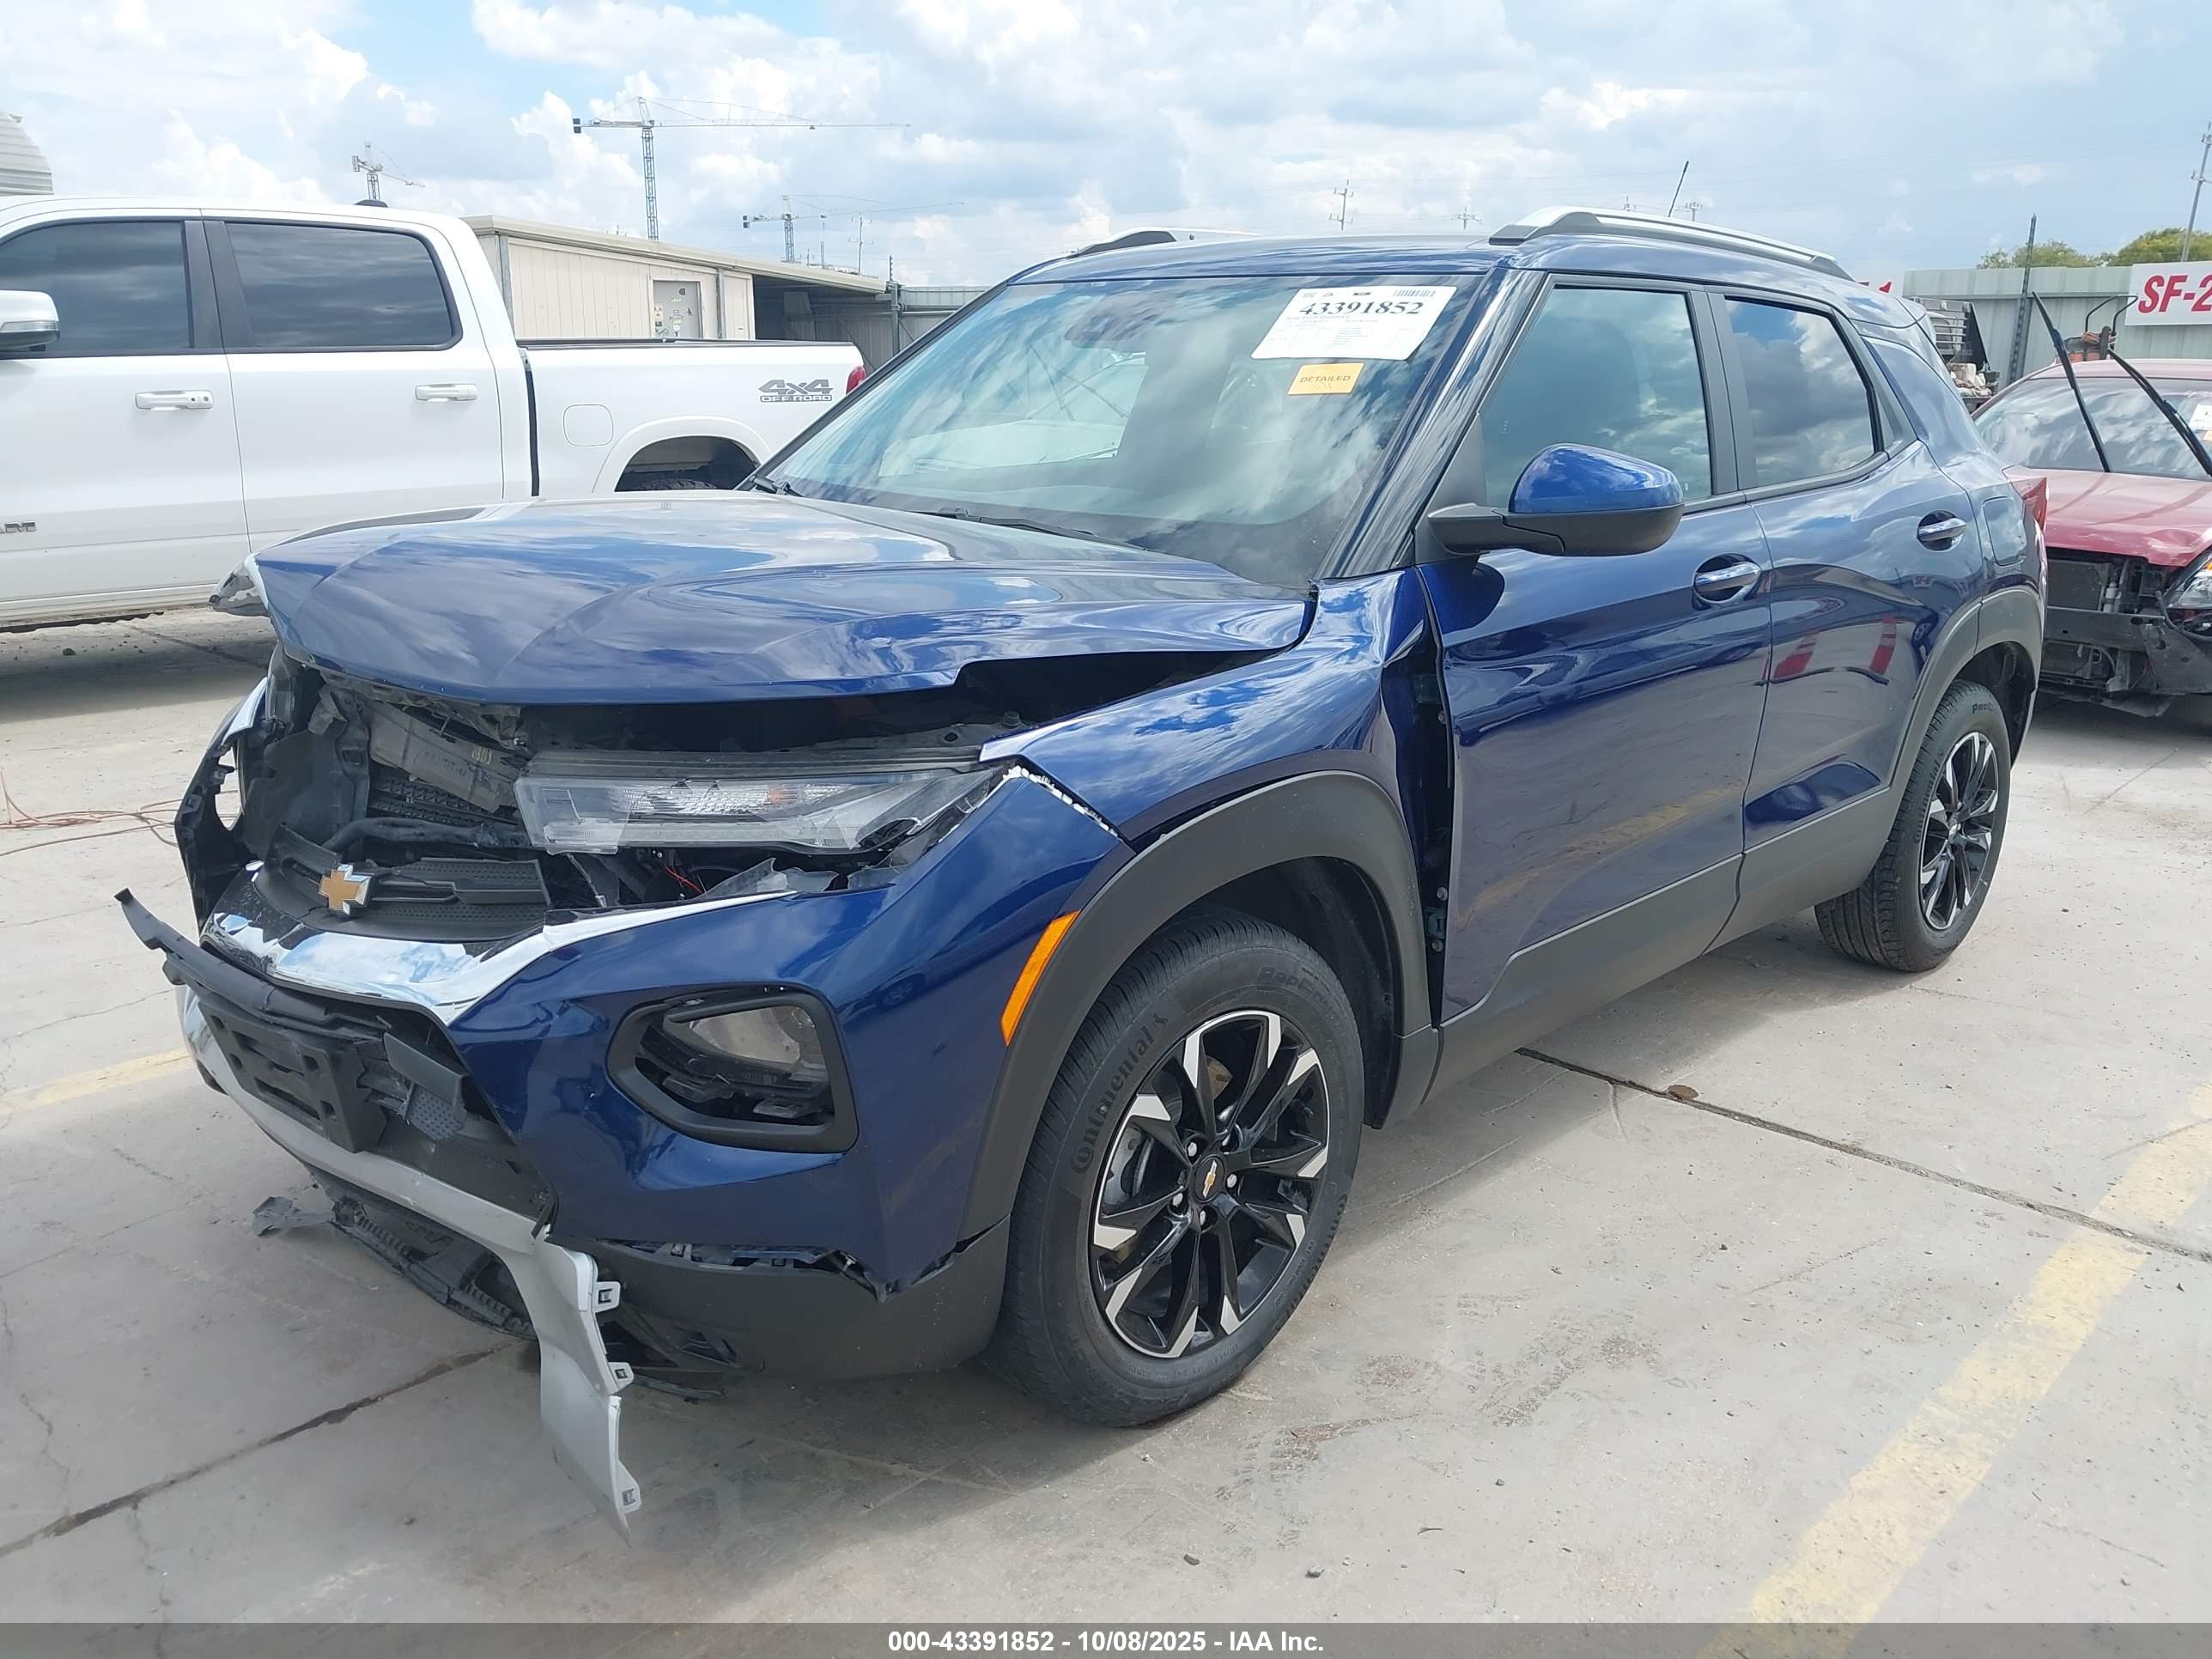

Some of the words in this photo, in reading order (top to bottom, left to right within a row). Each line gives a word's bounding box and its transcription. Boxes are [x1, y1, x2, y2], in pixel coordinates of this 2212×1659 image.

[1299, 301, 1424, 315] 43391852
[758, 380, 834, 395] 4x4
[1072, 1025, 1154, 1174] Continental
